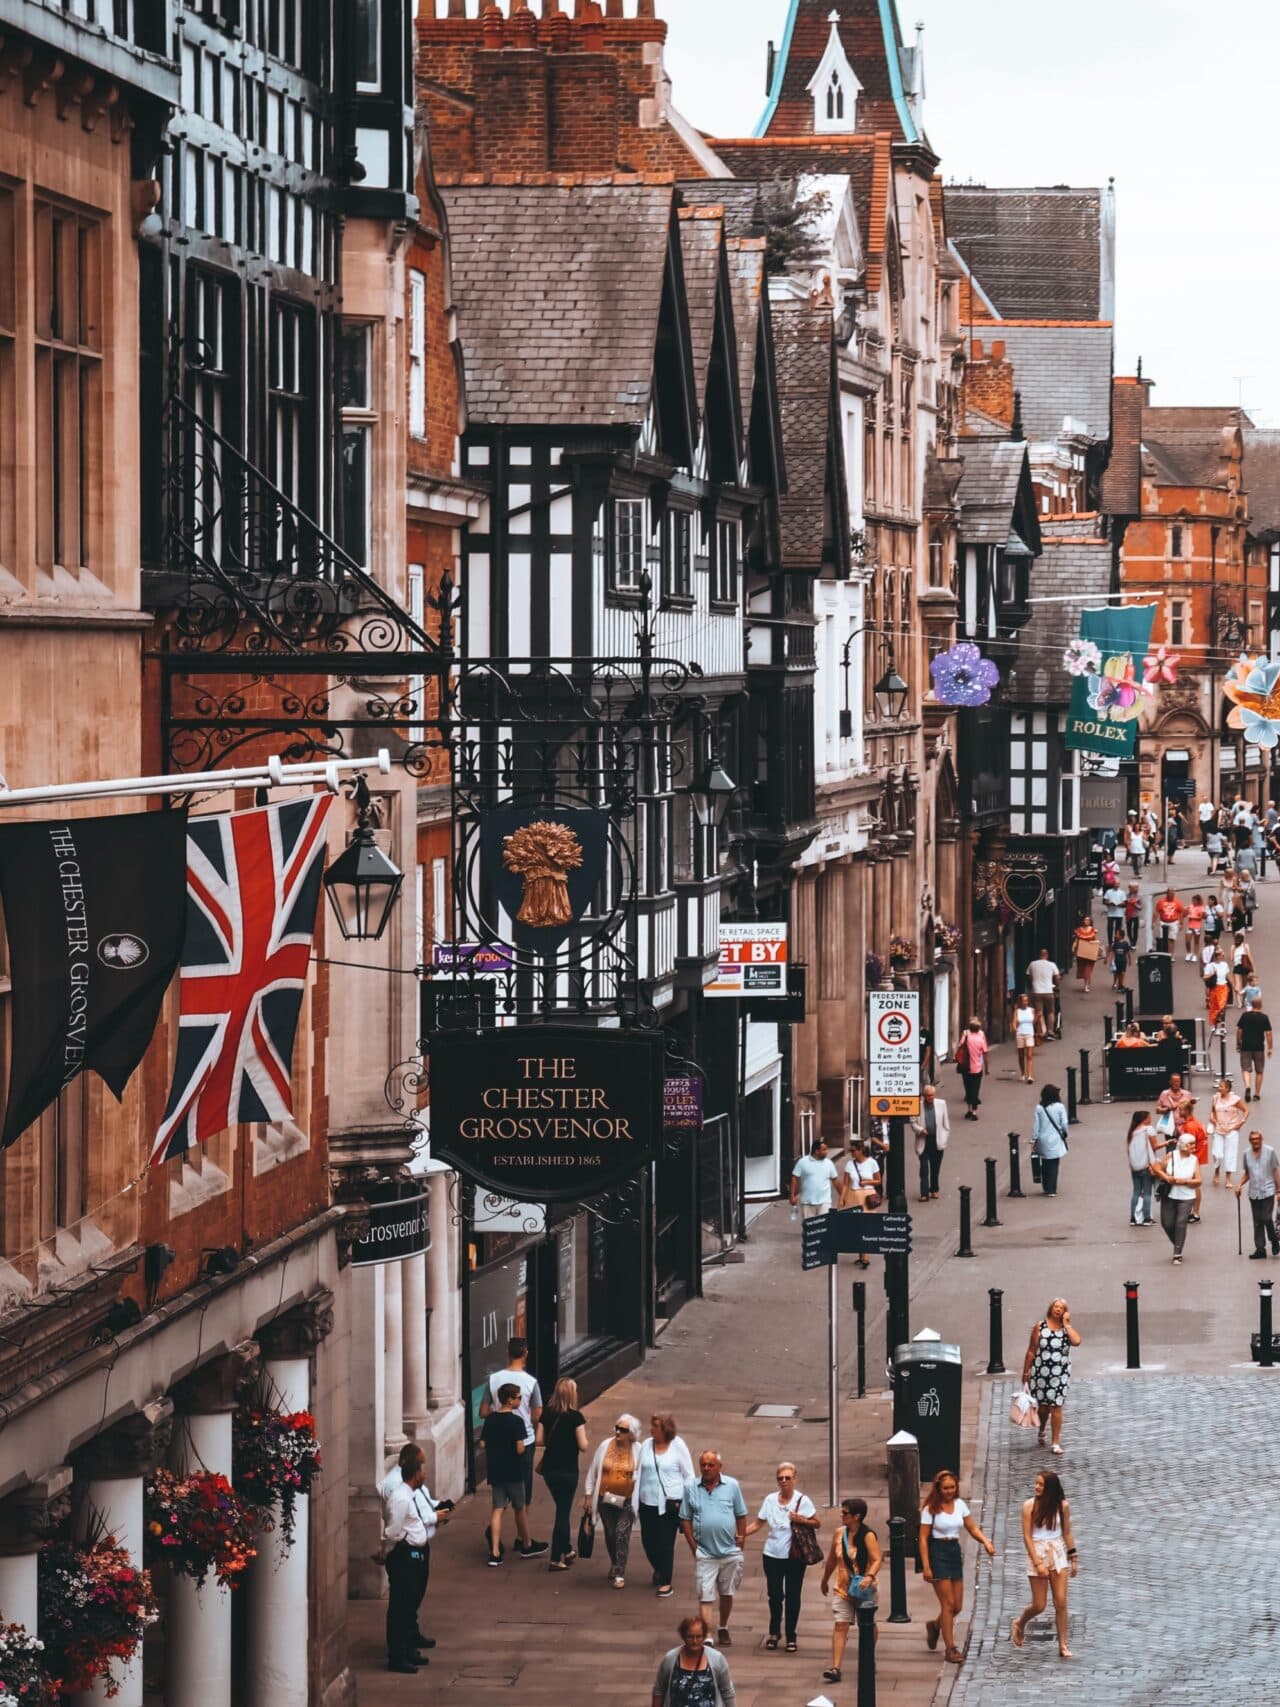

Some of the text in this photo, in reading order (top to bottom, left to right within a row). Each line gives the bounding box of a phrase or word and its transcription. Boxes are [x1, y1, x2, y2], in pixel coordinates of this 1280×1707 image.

[1072, 720, 1128, 740] ROLEX
[50, 826, 76, 858] THE
[58, 860, 89, 958] CHESTER
[718, 943, 781, 962] ET BY
[878, 1000, 910, 1009] ZONE
[517, 1058, 576, 1080] THE
[481, 1088, 610, 1110] CHESTER
[459, 1118, 634, 1140] GROSVENOR
[494, 1155, 601, 1166] ESTABLISHED 1865
